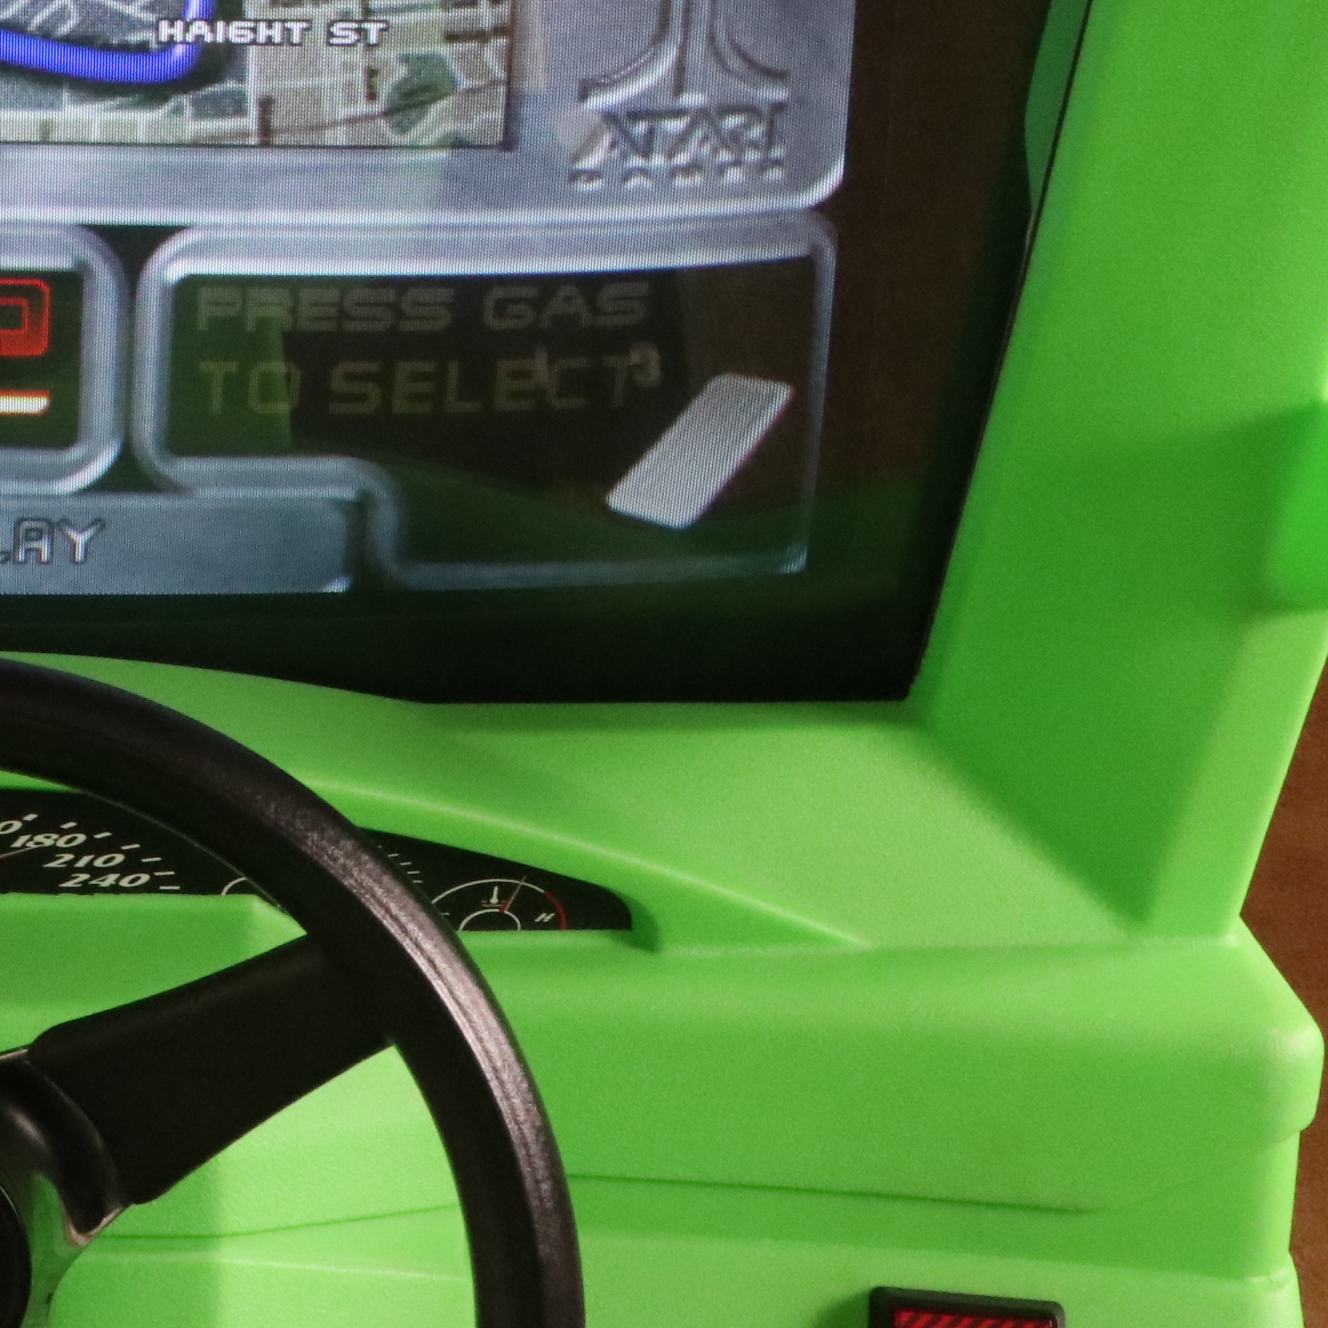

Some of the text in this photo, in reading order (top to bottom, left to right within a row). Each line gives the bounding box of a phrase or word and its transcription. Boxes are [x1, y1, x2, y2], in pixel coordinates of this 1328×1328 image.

[156, 18, 390, 48] HAIGHT ST
[570, 102, 789, 170] ATARI
[195, 280, 651, 333] PRESS GAS
[198, 354, 637, 415] TO SELECT
[9, 832, 88, 849] 180
[41, 853, 126, 869] 210
[58, 872, 151, 888] 240
